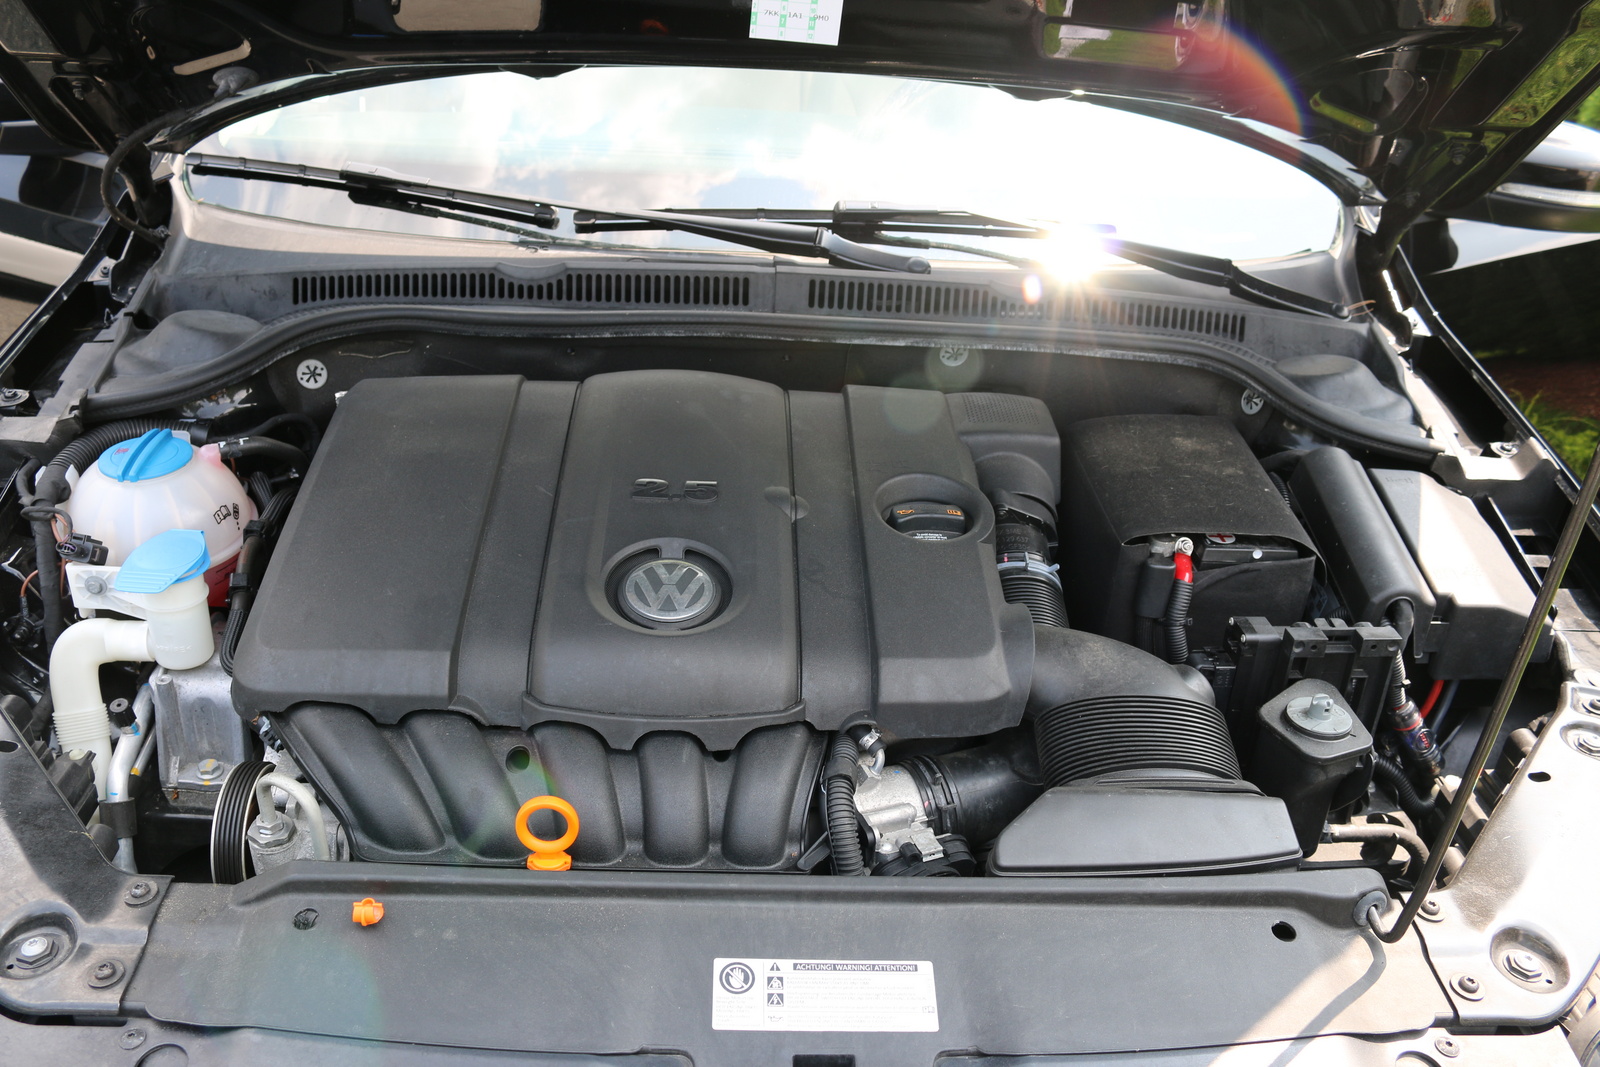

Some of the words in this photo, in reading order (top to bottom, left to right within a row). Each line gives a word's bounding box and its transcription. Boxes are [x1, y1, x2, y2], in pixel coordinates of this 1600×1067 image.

[763, 9, 779, 17] 7KK
[632, 478, 718, 503] 2.5
[625, 559, 714, 621] VW
[796, 963, 834, 971] ACHTUNG!
[835, 964, 873, 972] WARNING!
[874, 964, 916, 972] ATTENTION!
